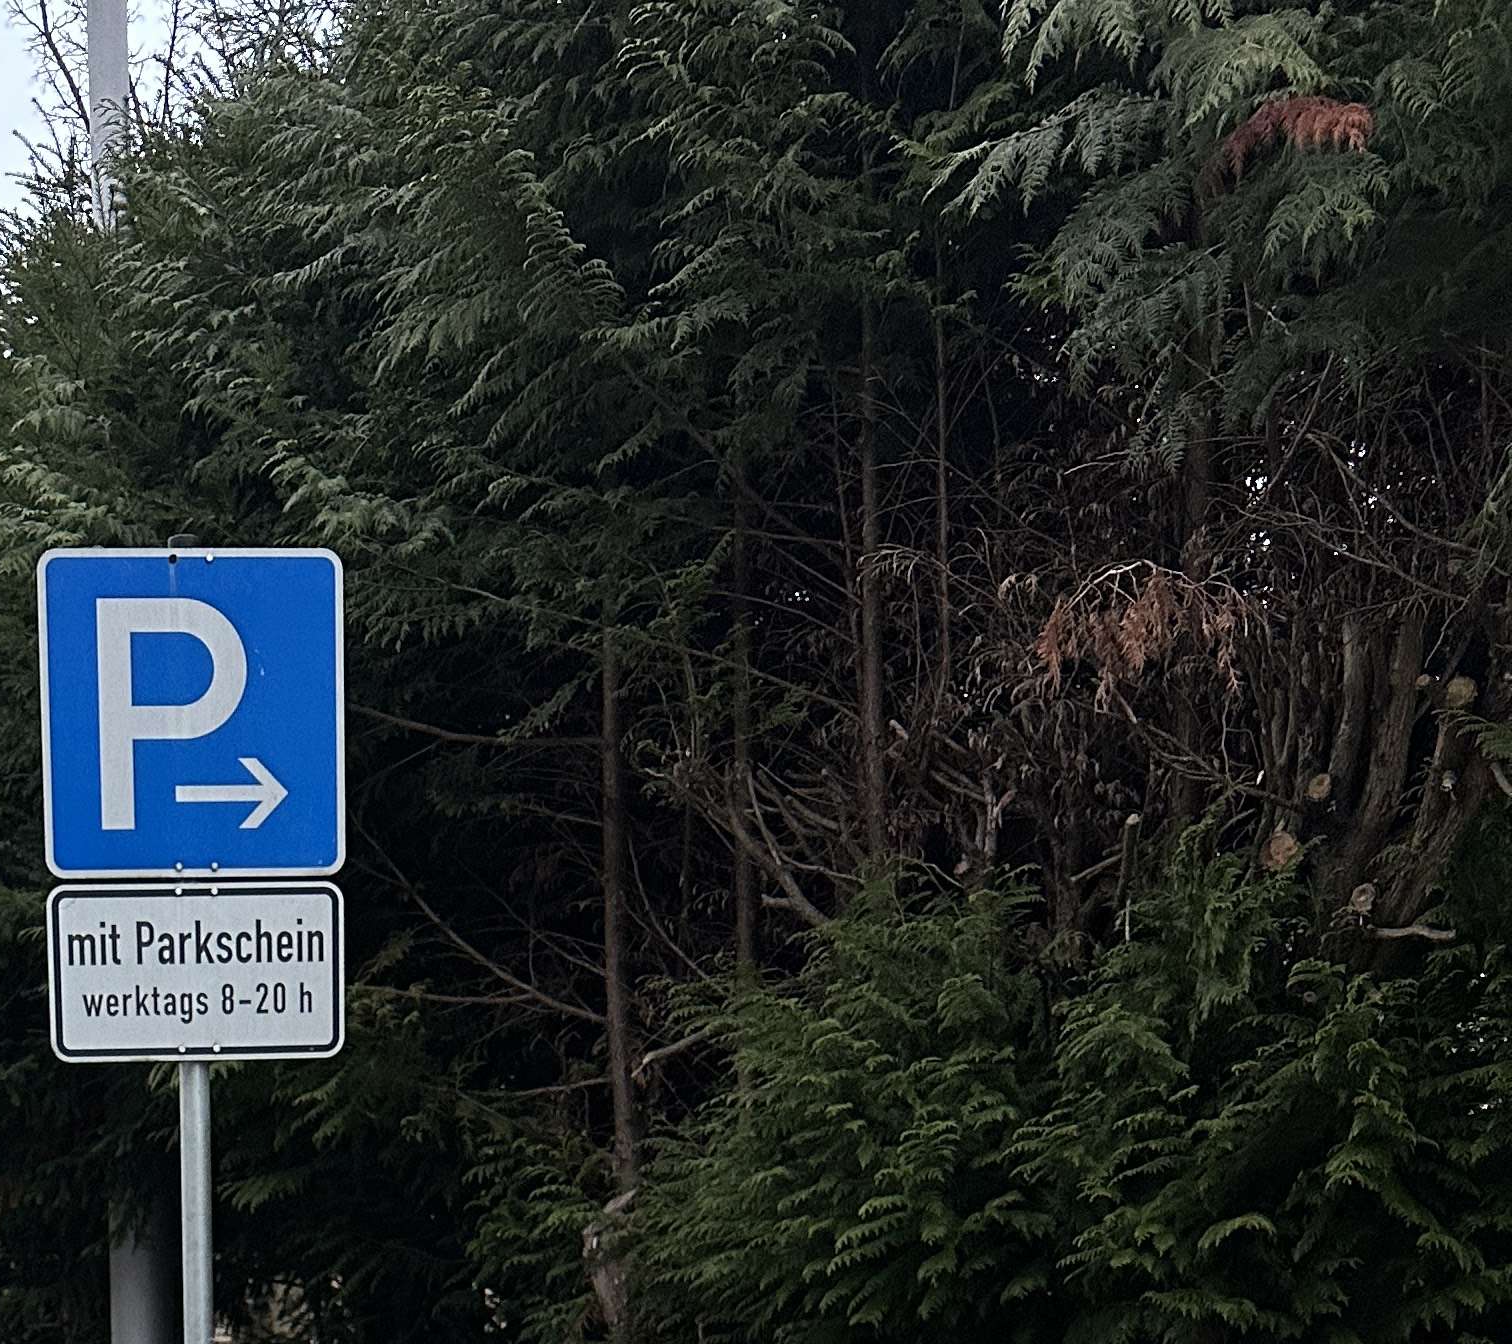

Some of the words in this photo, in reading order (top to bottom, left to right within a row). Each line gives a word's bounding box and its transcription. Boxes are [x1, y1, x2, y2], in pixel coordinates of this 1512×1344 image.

[96, 597, 248, 830] P
[67, 921, 122, 966] mit
[135, 918, 325, 965] Parkschein
[82, 985, 209, 1024] werktags
[221, 983, 287, 1015] 8-20
[299, 982, 313, 1013] h
